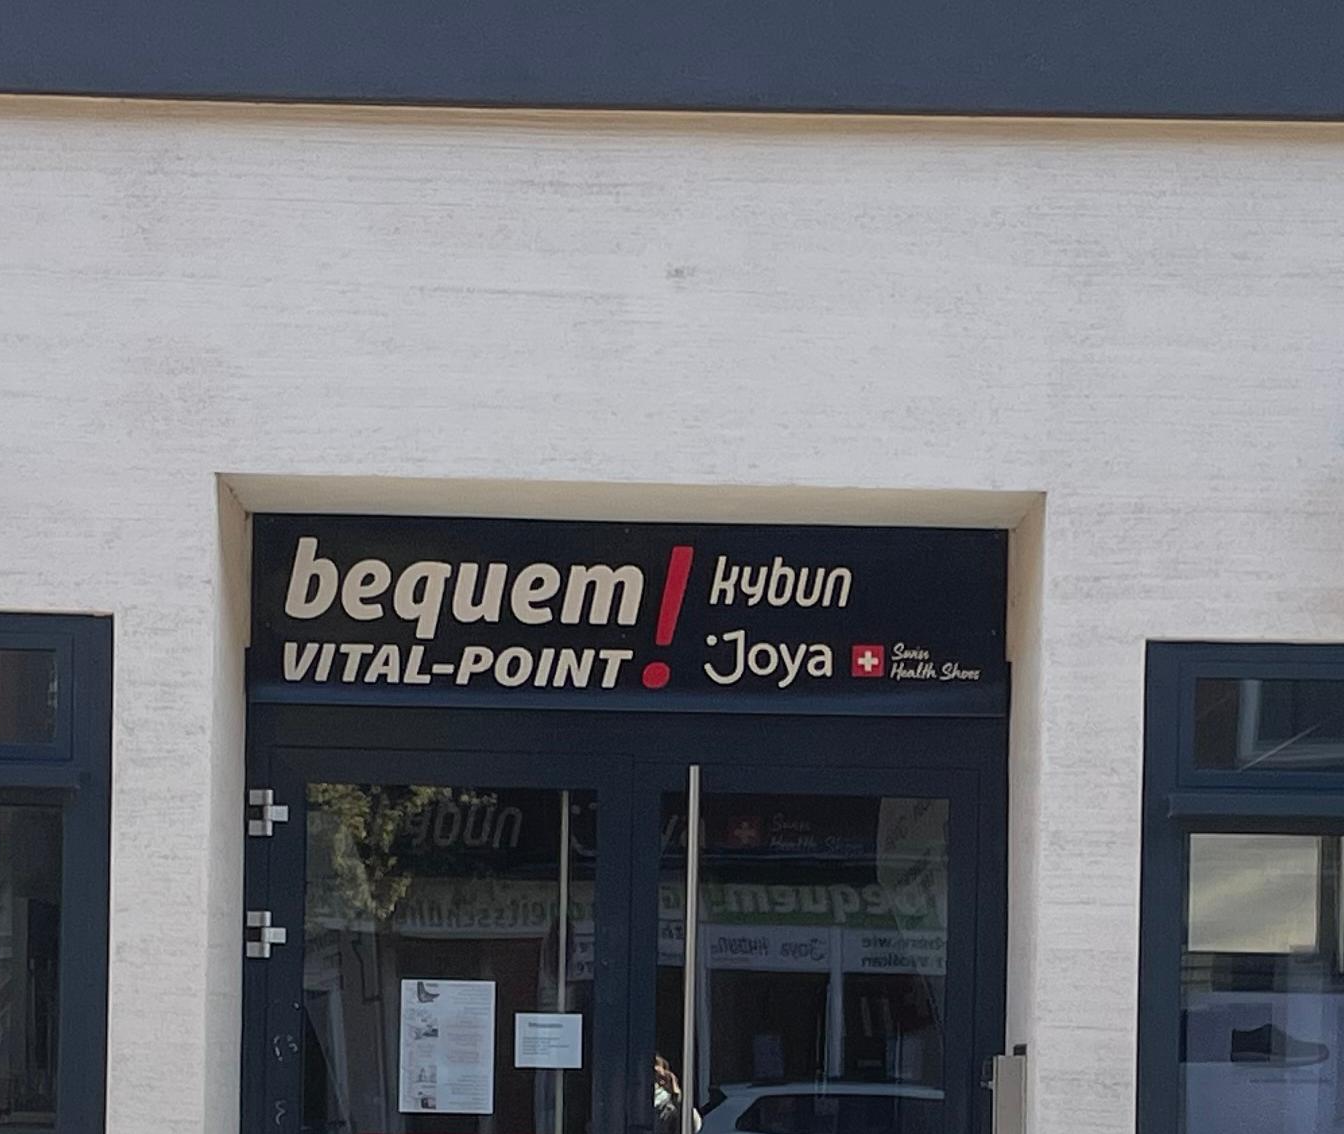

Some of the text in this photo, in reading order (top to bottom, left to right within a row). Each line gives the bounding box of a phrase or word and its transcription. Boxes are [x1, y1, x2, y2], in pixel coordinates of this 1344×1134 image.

[709, 556, 852, 607] kybun
[284, 642, 633, 688] VITAL-POINT
[704, 630, 833, 688] Joya
[890, 662, 980, 680] Health Shoes
[891, 642, 929, 660] Swiss
